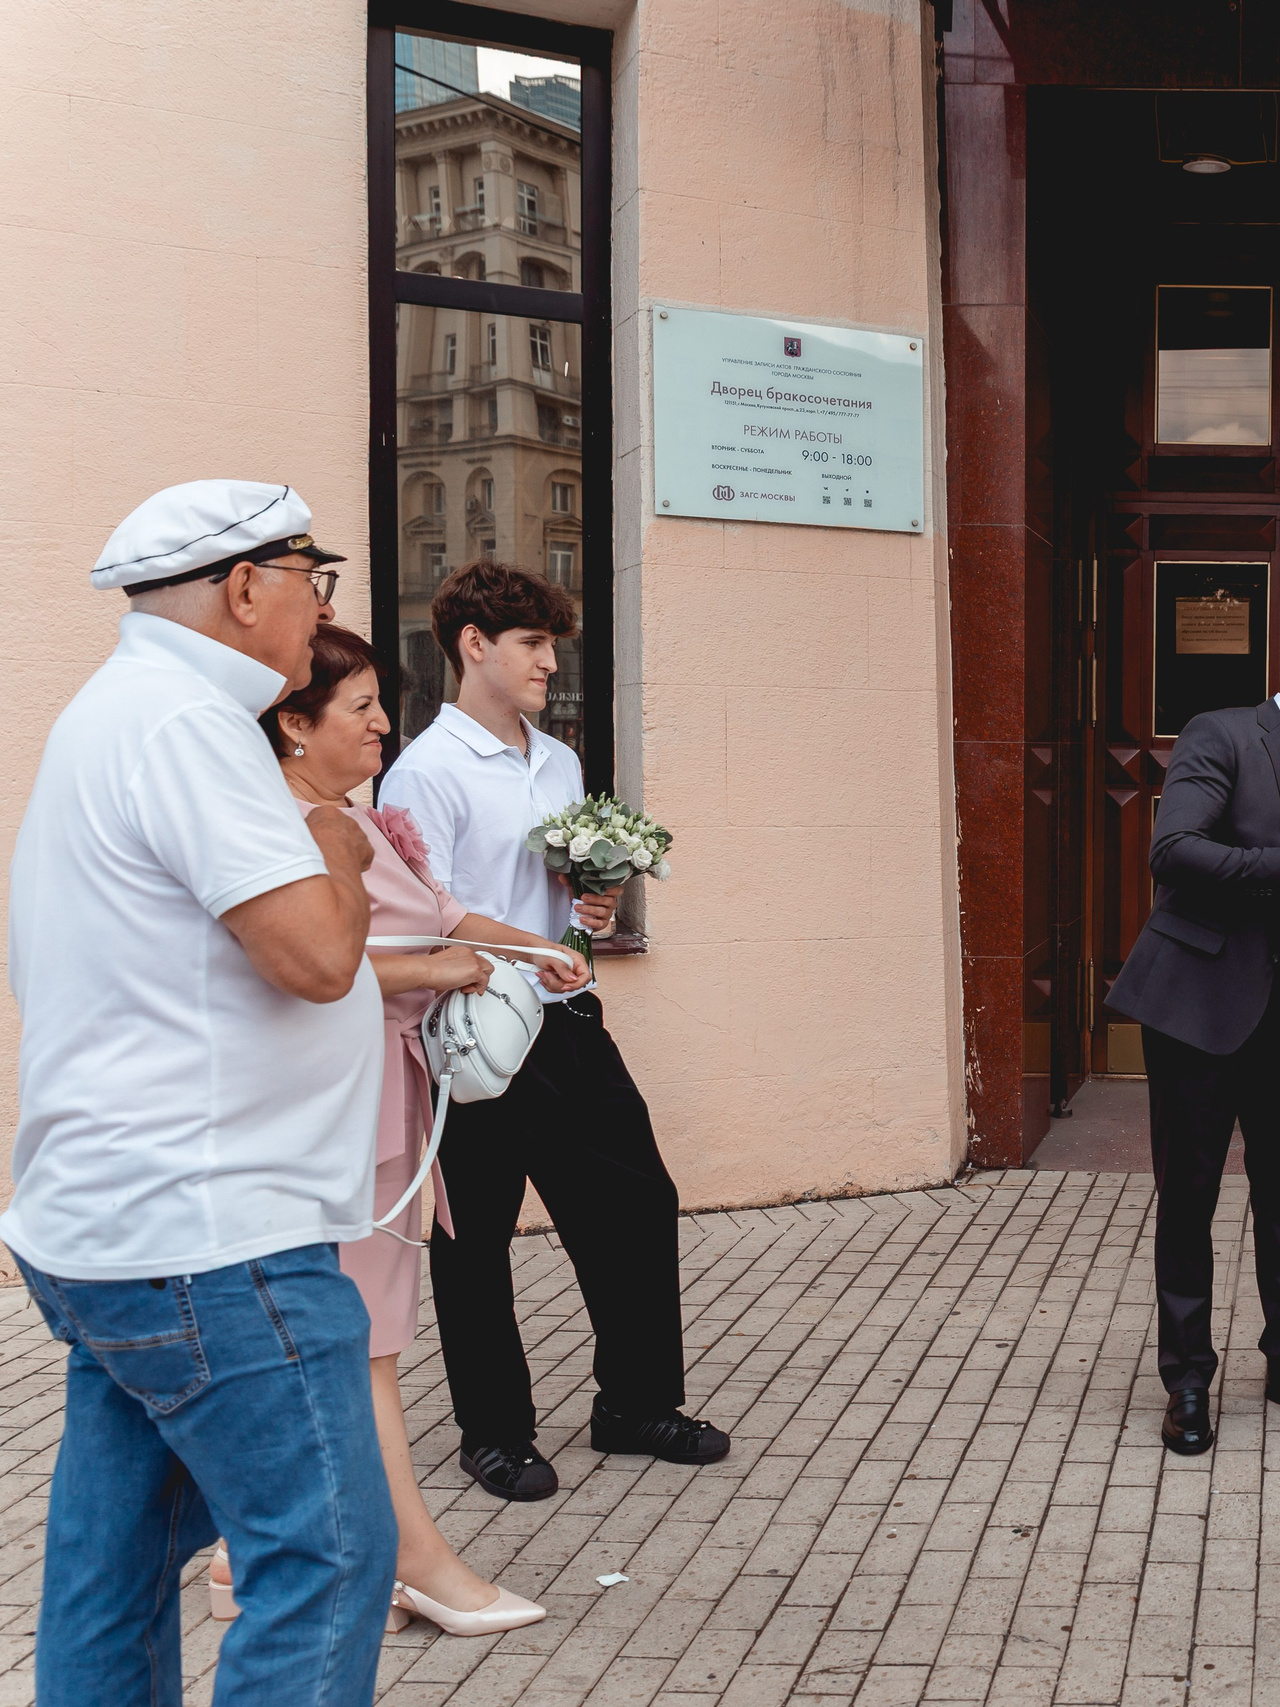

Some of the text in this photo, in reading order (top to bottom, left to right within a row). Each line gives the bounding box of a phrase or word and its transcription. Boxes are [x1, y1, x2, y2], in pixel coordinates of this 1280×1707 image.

[721, 357, 753, 366] УПРАВЛЕНИЕ
[793, 365, 832, 375] ГРАЖДАНСКОГО
[832, 370, 862, 378] СОСТОЯНИЯ
[710, 381, 872, 410] Дворец бракосочетания
[743, 424, 842, 444] РЕЖИМ РАБОТЫ
[711, 444, 736, 452] ВТОРНИК
[802, 449, 829, 462] 9:00
[841, 453, 872, 466] 18:00
[711, 463, 748, 472] ВОСКРЕСЕНЬЕ
[752, 467, 793, 475] ПОНЕДЕЛЬНИК
[821, 473, 852, 481] ВЫХОДНОЙ
[740, 491, 796, 502] ЗАГС МОСКВЫ
